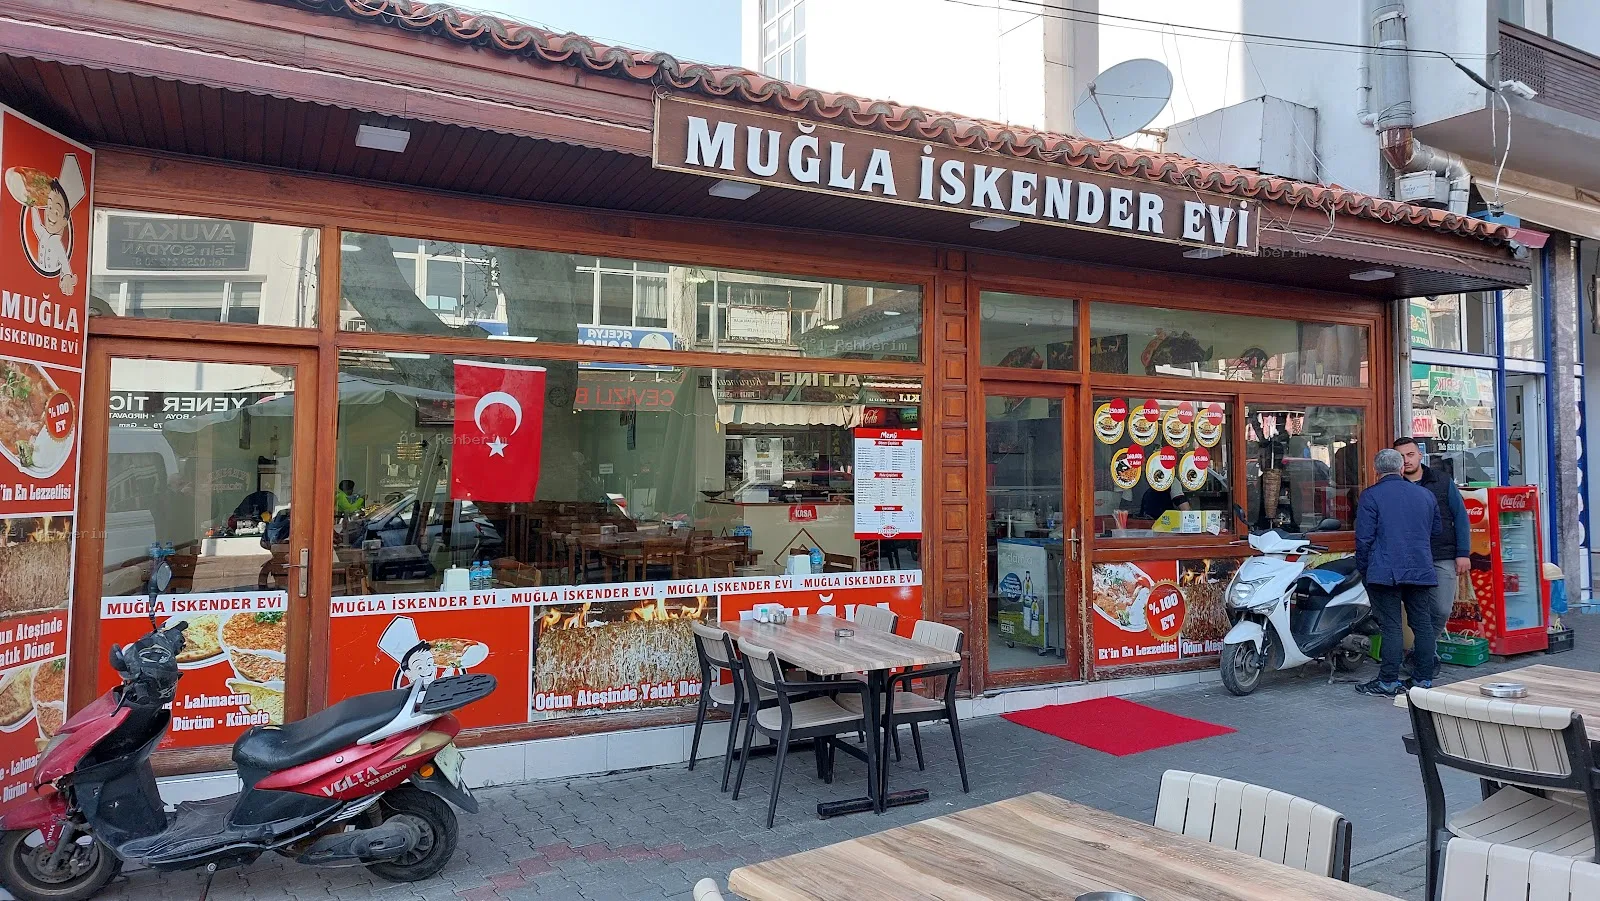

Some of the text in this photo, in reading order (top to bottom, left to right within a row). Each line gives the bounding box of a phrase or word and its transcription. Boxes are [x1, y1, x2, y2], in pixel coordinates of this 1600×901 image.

[685, 115, 1249, 248] MUĞLA İSKENDER EVİ
[2, 290, 80, 334] MUĞLA
[0, 323, 79, 355] İSKENDER EVİ
[55, 421, 67, 433] ET
[15, 484, 27, 500] En
[29, 483, 72, 500] Lezzetlisi
[1500, 494, 1526, 509] Coca-Cola
[795, 509, 812, 518] KASA
[331, 598, 387, 614] MUĞLA
[391, 595, 468, 610] İSKENDER
[472, 591, 497, 607] EVİ
[511, 588, 559, 604] MUĞLA
[563, 585, 630, 602] İSKENDER
[634, 583, 655, 597] EVİ
[667, 582, 709, 596] MUĞLA
[713, 579, 771, 593] İSKENDER
[774, 578, 793, 589] EVİ
[844, 574, 896, 587] İSKENDER
[899, 572, 916, 584] EVİ
[107, 594, 282, 615] MUĞLA İSKENDER EVİ
[16, 617, 62, 642] Ateşinde
[1160, 614, 1176, 631] ET
[23, 638, 55, 662] Döner
[1098, 642, 1177, 660] Et'in En Lezzetlisi
[1182, 641, 1203, 655] Odun
[183, 693, 251, 710] Lahmacun
[535, 692, 573, 710] Odun
[576, 685, 638, 708] Ateşinde
[640, 681, 676, 700] Yatık
[172, 714, 215, 732] Dürüm
[225, 709, 270, 727] Künefe
[321, 765, 380, 797] VOLTA
[379, 763, 407, 782] 2000W
[3, 782, 28, 804] Dürüm
